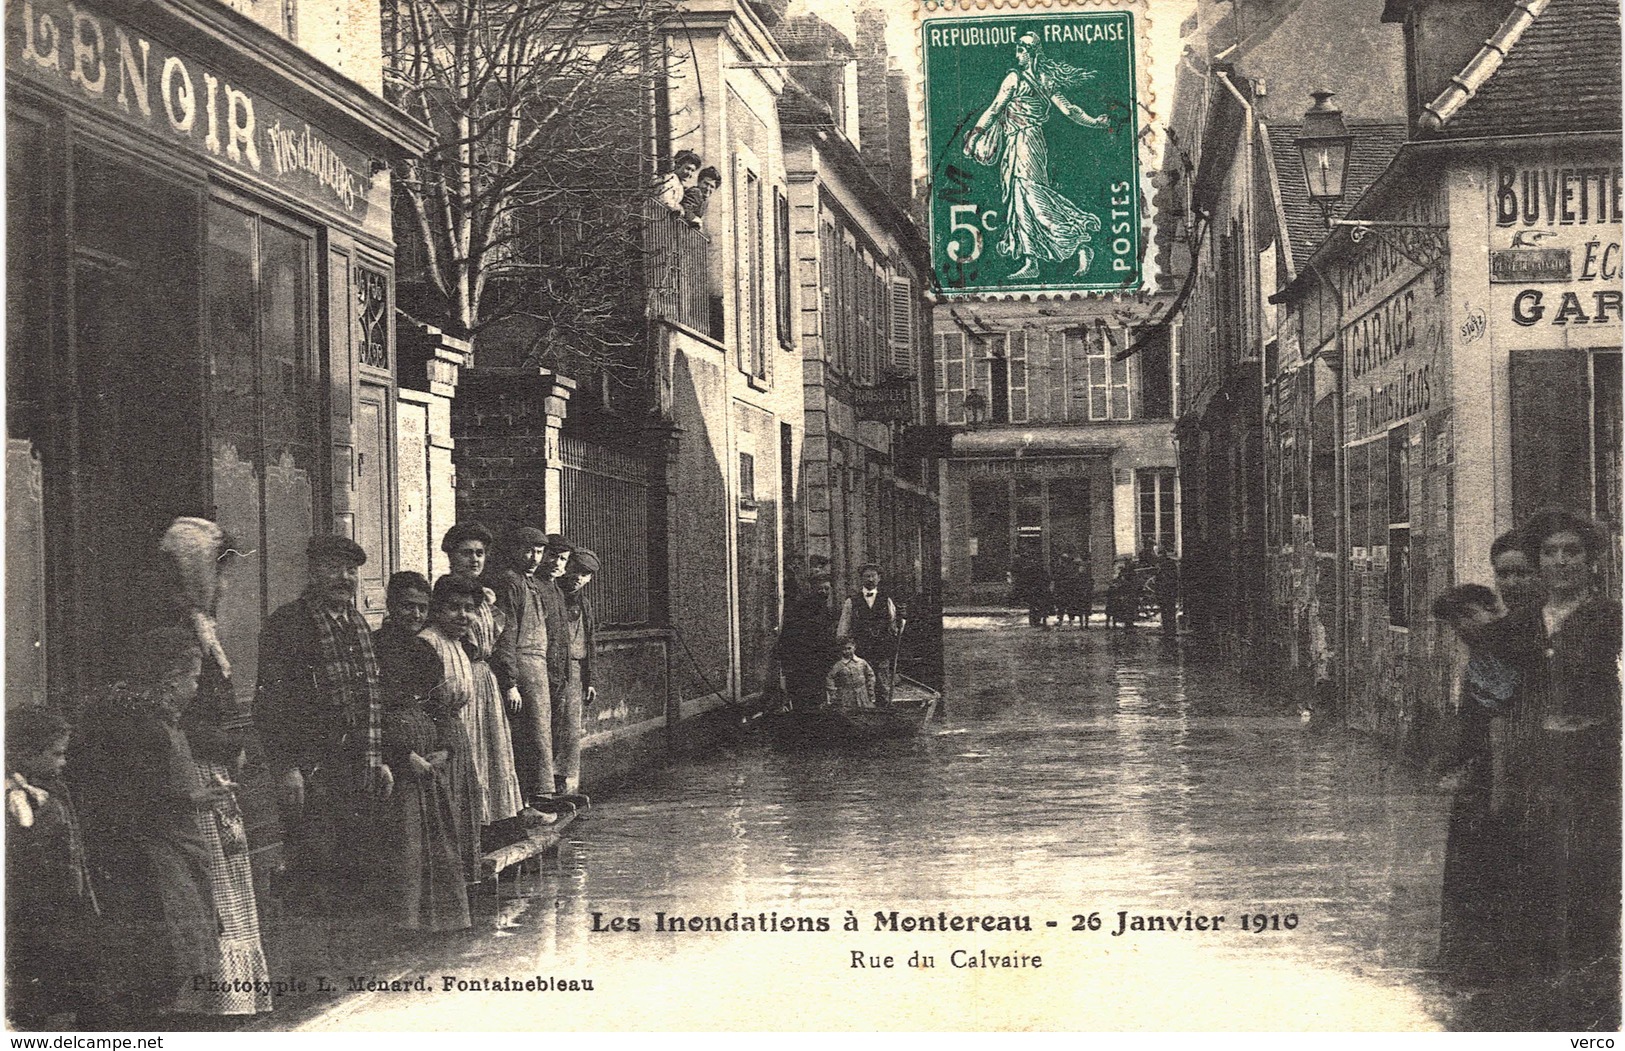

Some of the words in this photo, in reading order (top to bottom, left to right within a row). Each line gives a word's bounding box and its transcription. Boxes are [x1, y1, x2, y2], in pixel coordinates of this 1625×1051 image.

[1044, 23, 1125, 45] FRANÇAISE
[22, 0, 261, 173] LENOIR
[1113, 181, 1130, 272] POSTES
[1495, 166, 1623, 227] BUVETTE
[1578, 234, 1623, 282] ÉC
[1353, 289, 1416, 380] GARAGE
